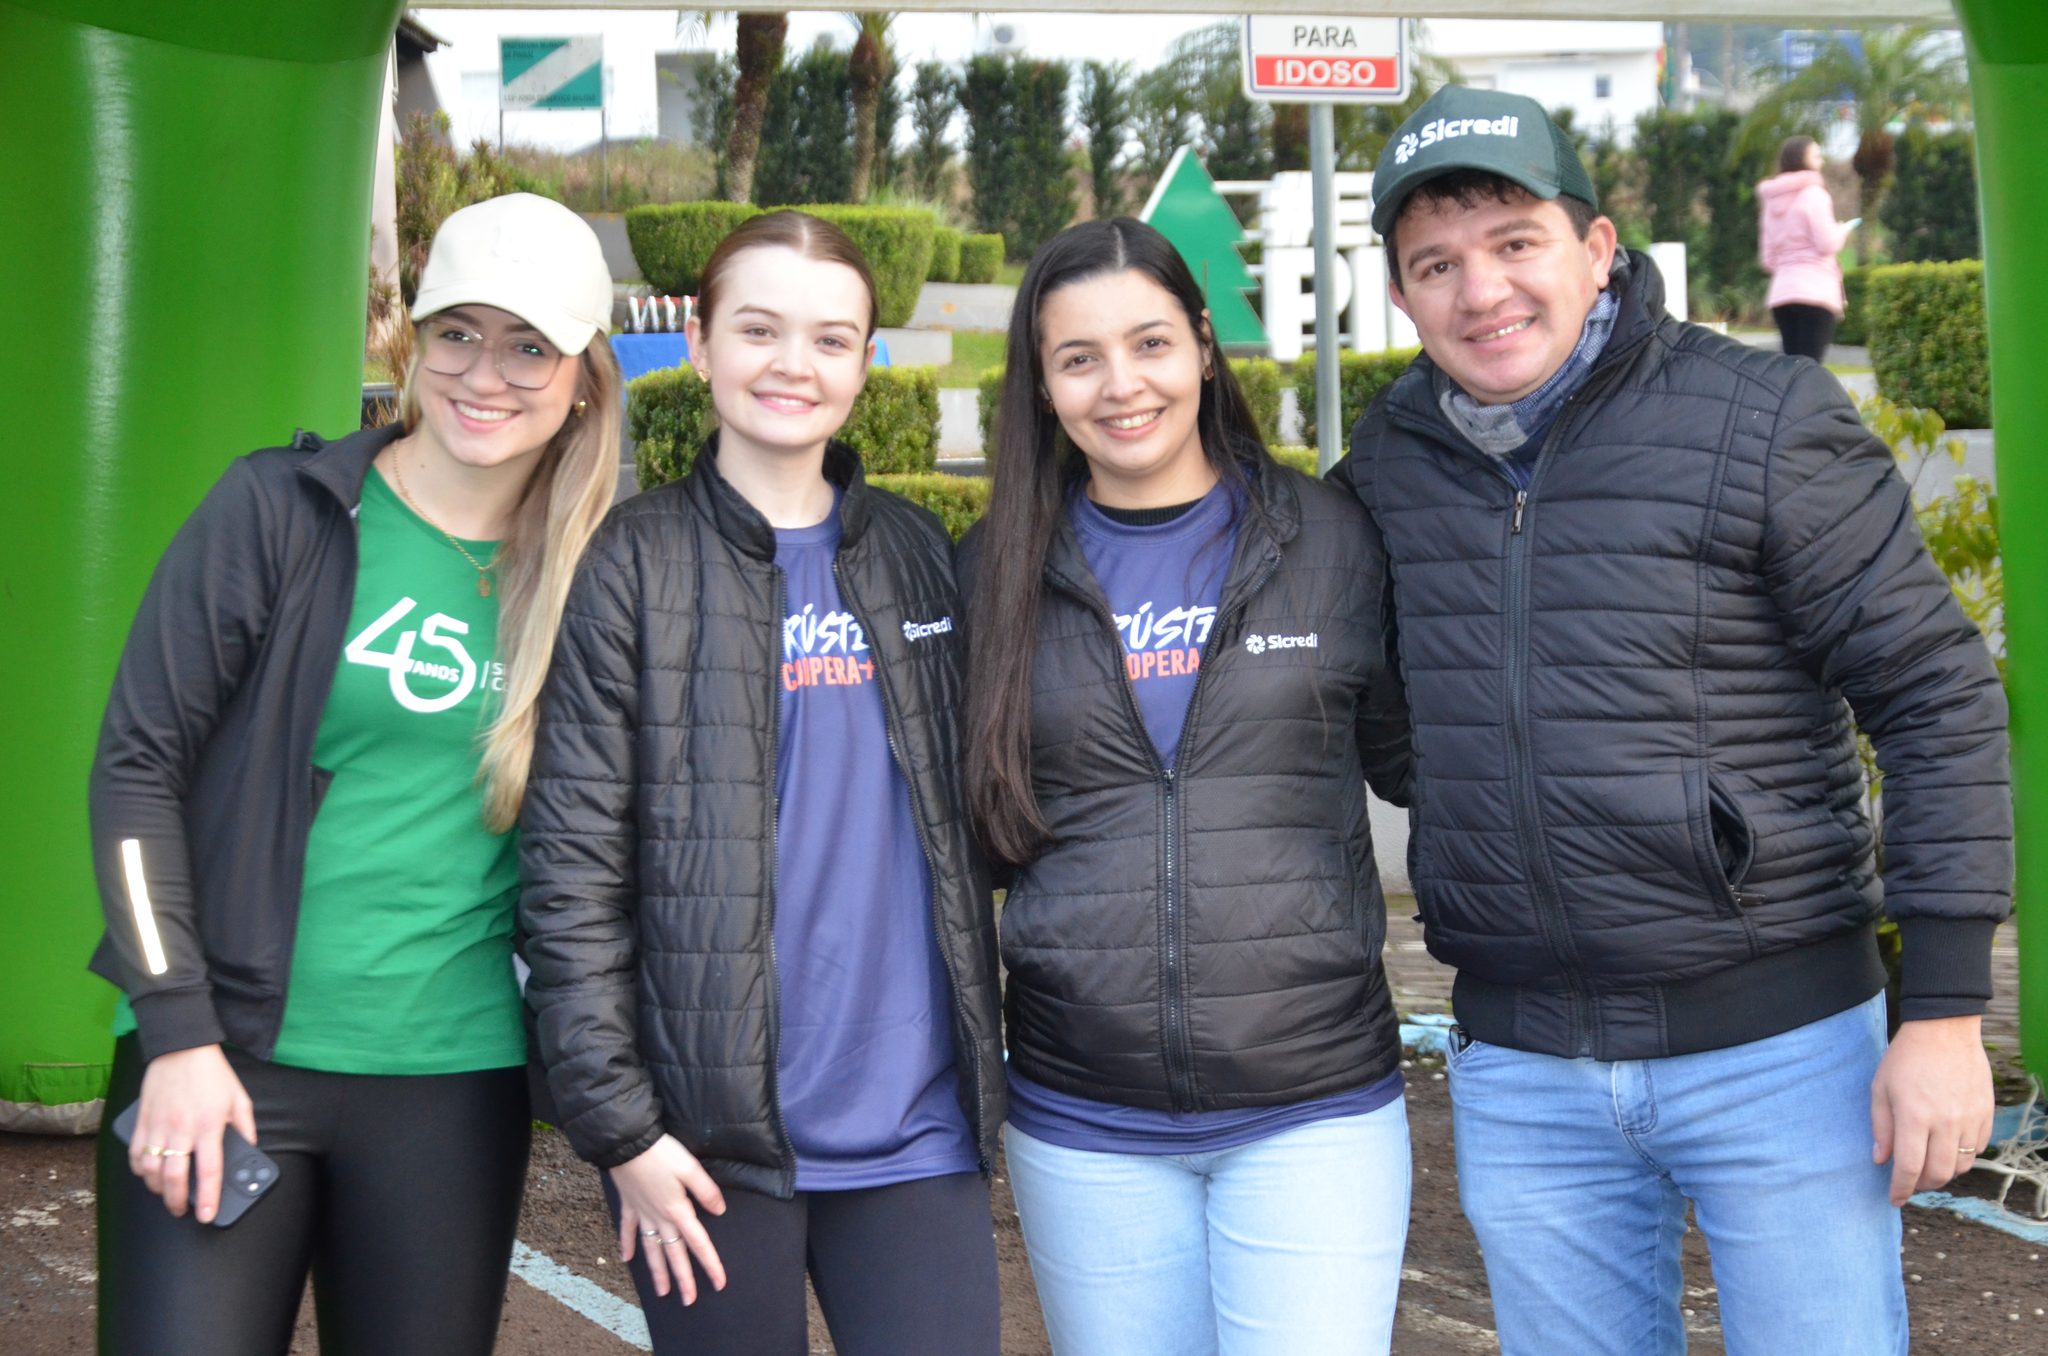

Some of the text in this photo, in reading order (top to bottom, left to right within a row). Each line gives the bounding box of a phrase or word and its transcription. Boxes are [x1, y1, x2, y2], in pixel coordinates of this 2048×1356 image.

[1294, 25, 1357, 48] PARA
[1275, 59, 1377, 85] IDOSO
[1419, 115, 1519, 149] Sicredi
[1267, 632, 1319, 650] Sicredi
[345, 596, 477, 713] 45
[411, 659, 461, 683] ANOS
